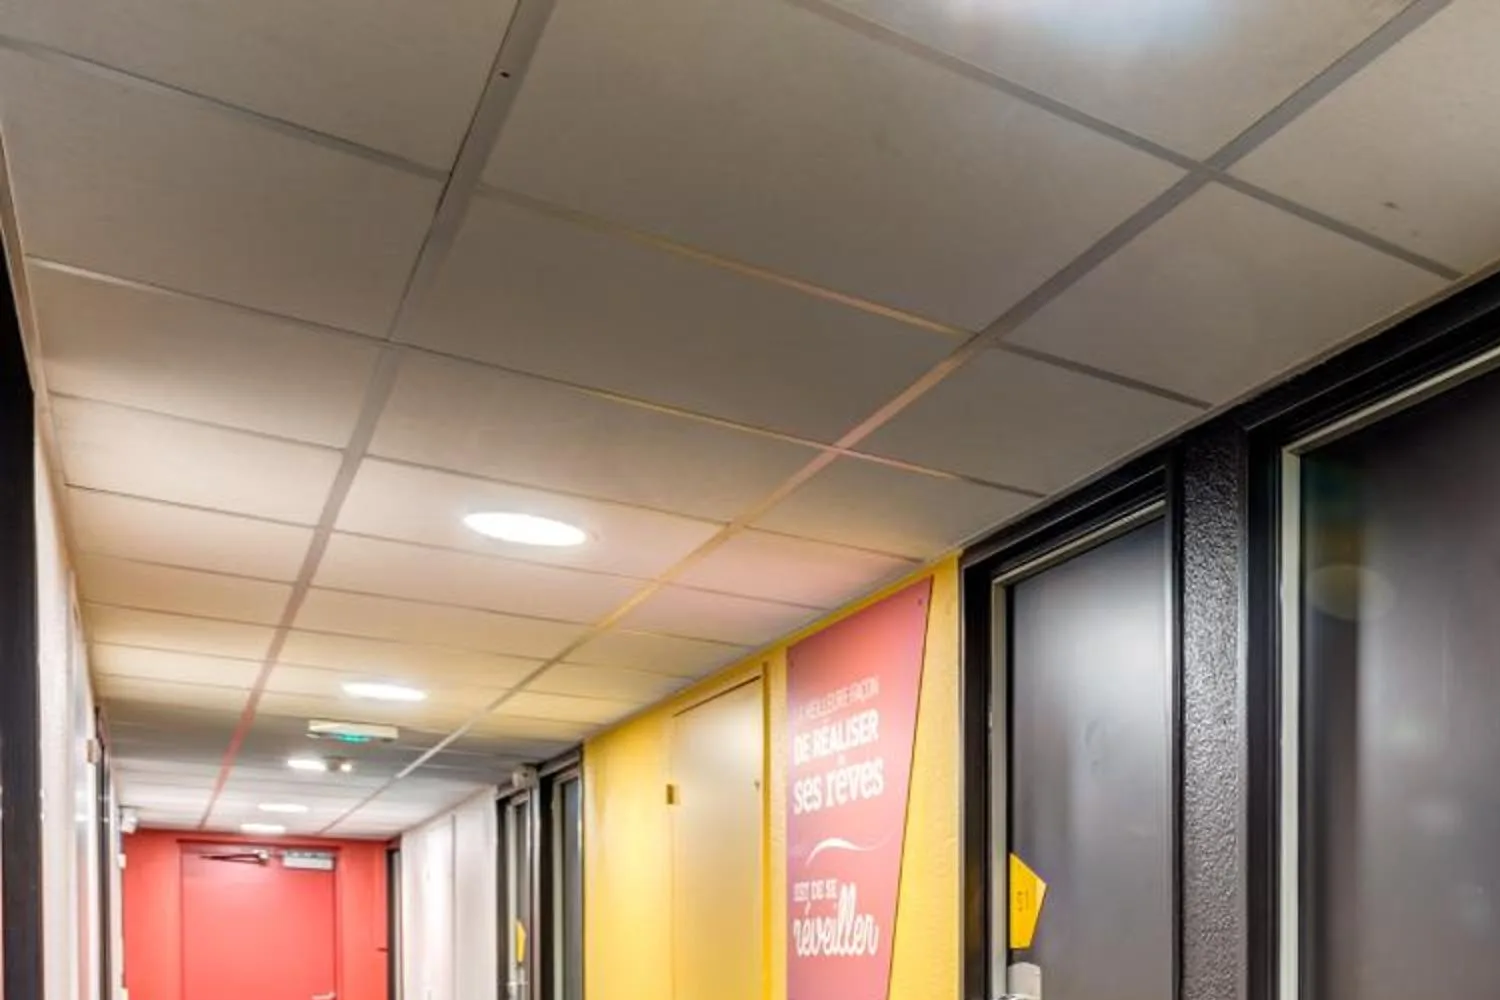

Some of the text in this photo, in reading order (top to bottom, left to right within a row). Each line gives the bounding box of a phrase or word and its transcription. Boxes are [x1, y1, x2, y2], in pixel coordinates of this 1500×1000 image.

[794, 732, 812, 766] DE
[793, 756, 884, 815] ses rêves
